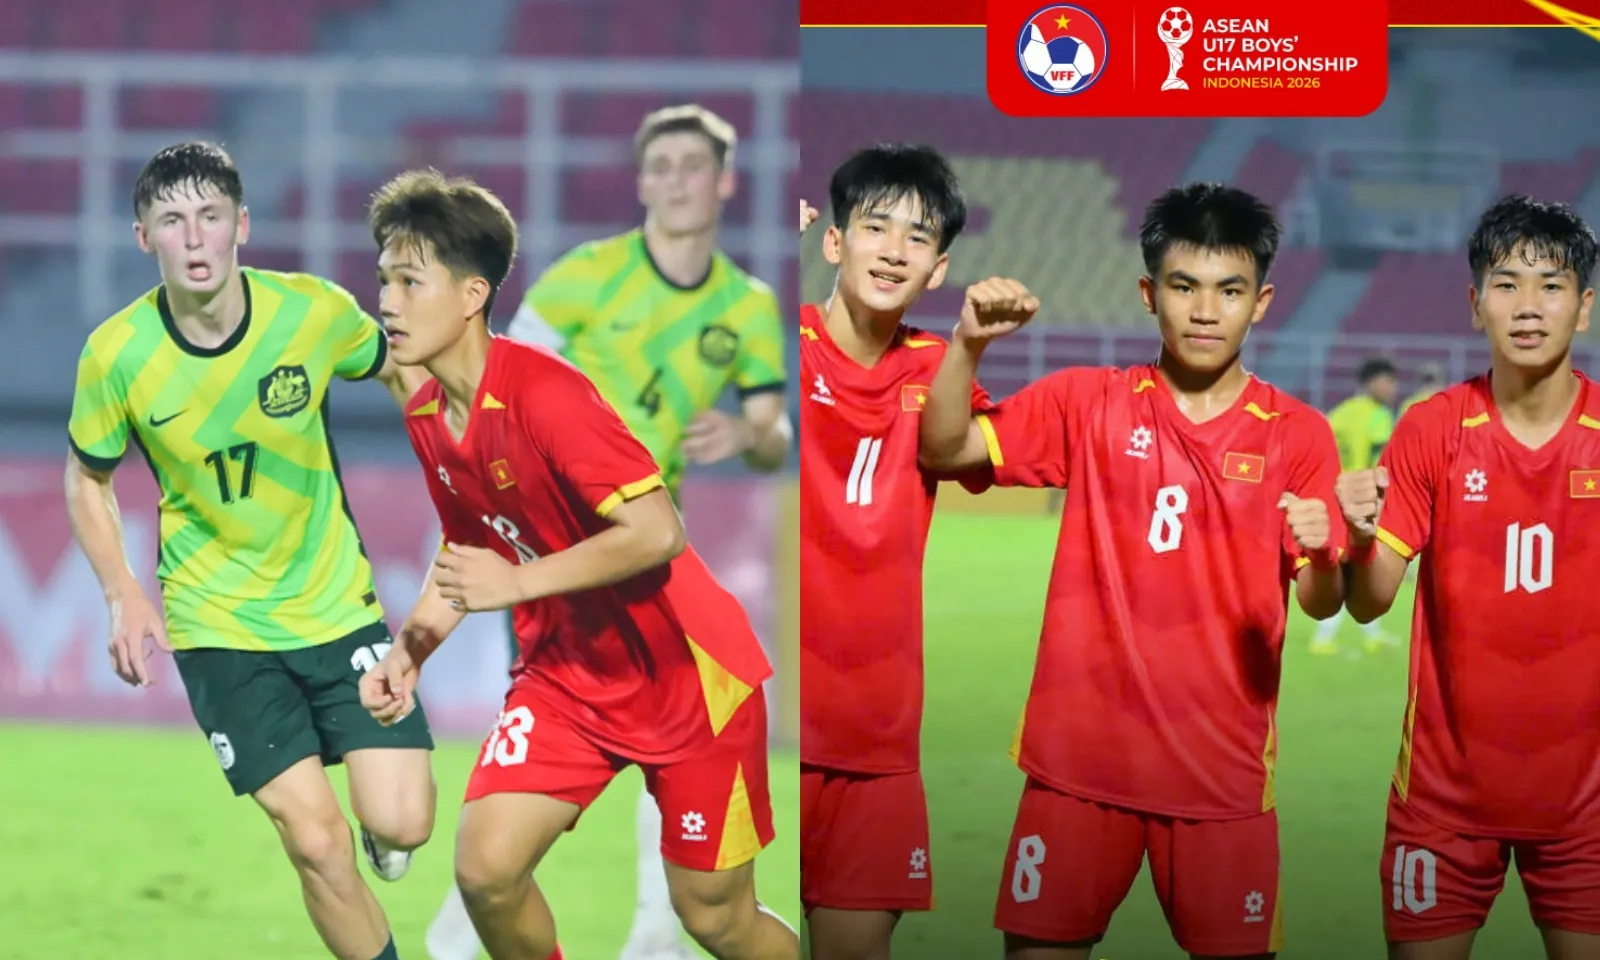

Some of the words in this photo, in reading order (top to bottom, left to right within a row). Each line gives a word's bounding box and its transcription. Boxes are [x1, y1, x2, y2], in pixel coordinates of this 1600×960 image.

[204, 441, 259, 504] 17
[846, 436, 883, 507] 11
[1147, 484, 1189, 554] 8
[1504, 521, 1554, 594] 10
[480, 705, 536, 768] 13
[1011, 834, 1046, 904] 8
[1392, 845, 1437, 914] 10
